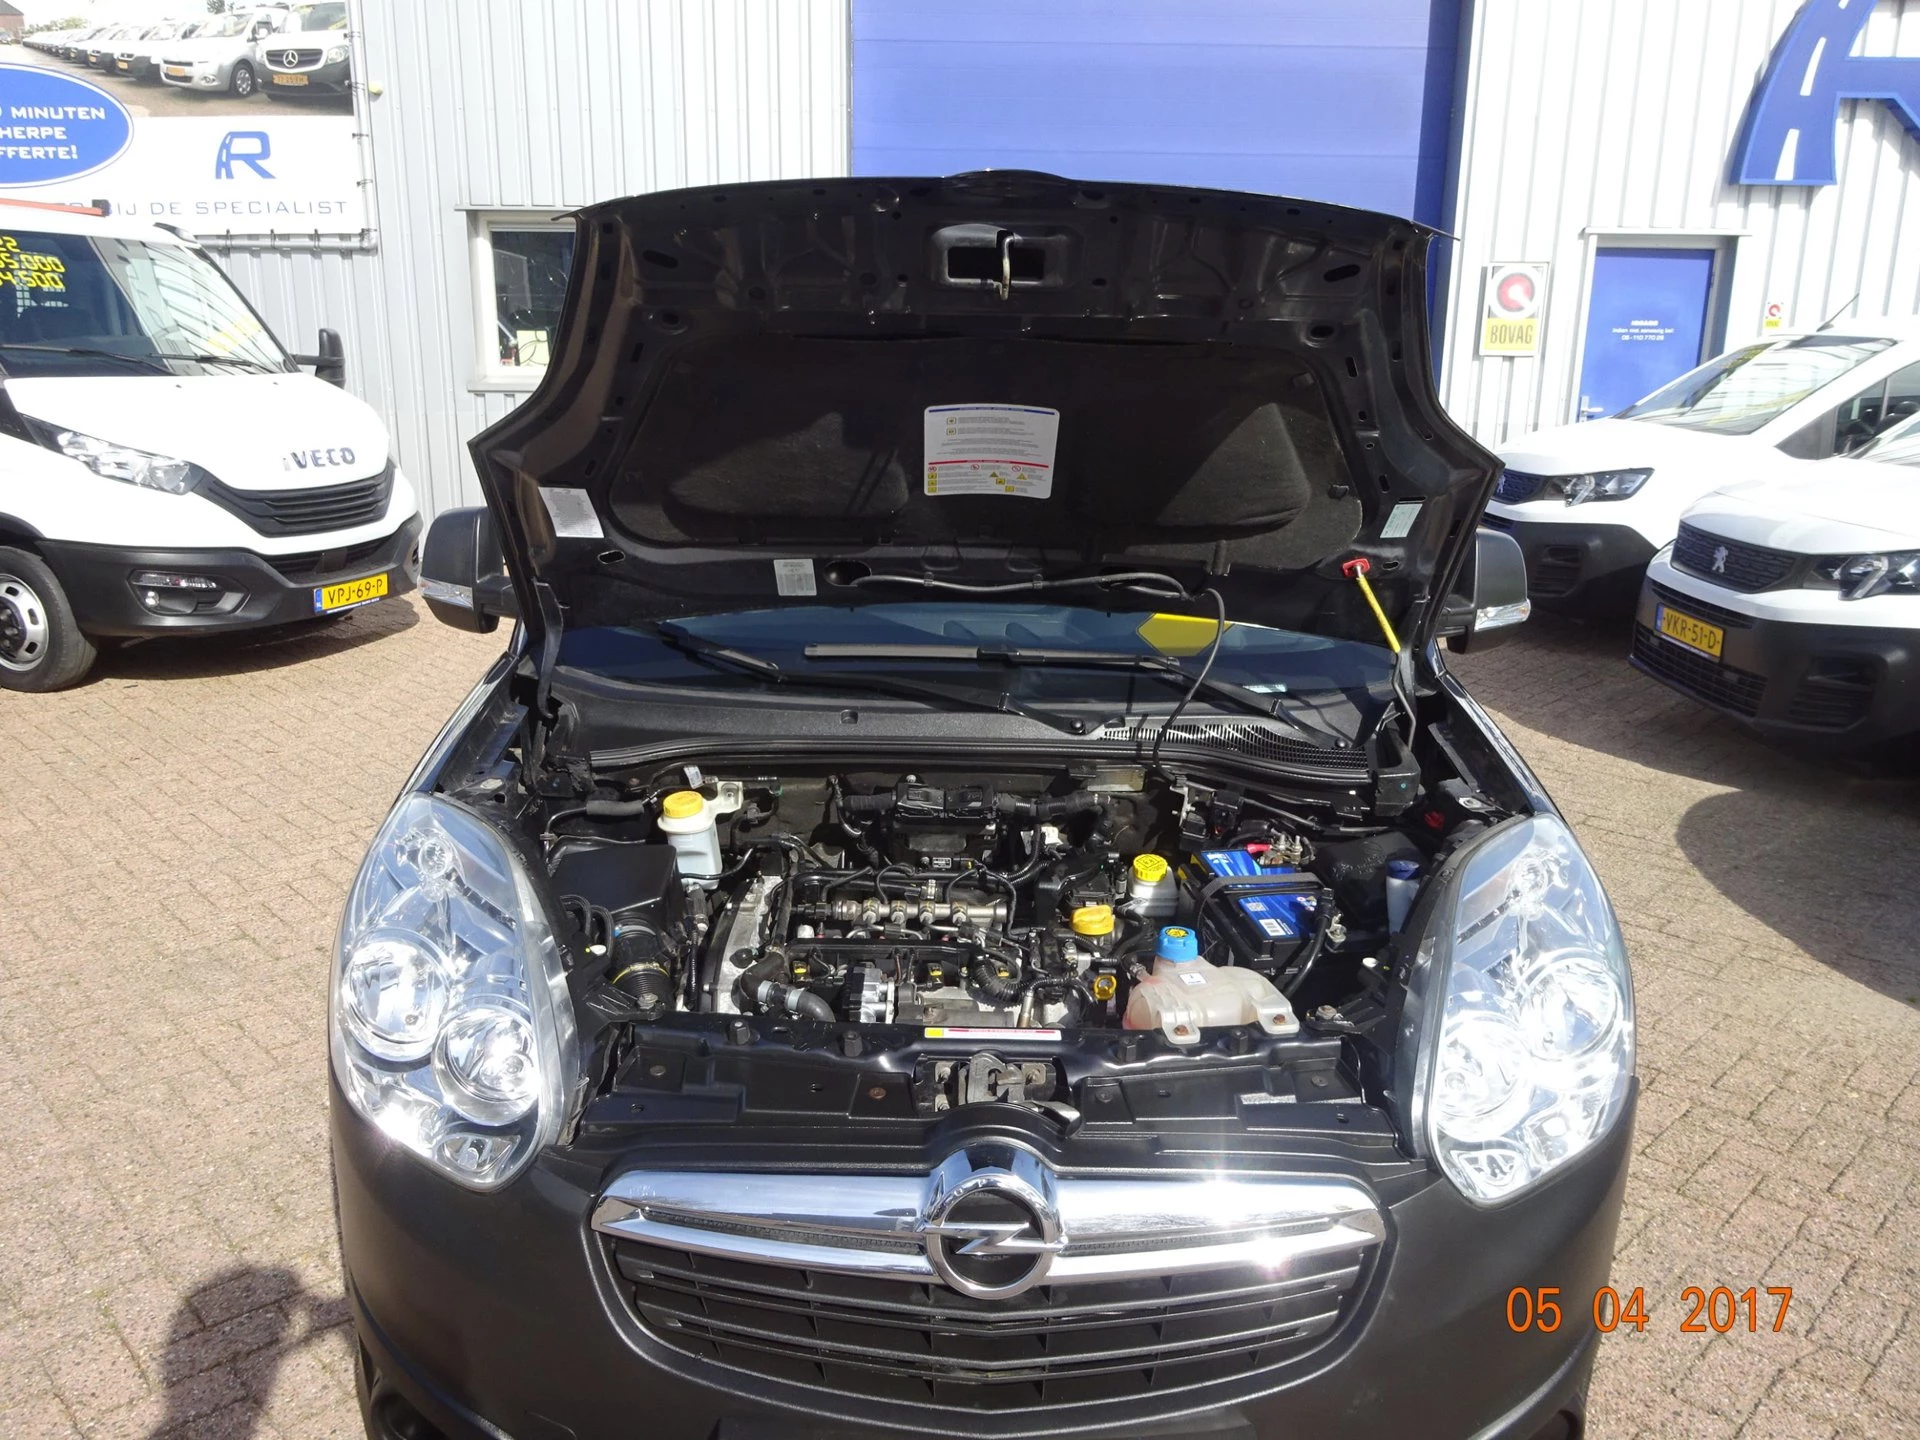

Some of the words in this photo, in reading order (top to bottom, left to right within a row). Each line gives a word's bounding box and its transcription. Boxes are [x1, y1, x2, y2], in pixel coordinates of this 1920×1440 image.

[10, 106, 106, 120] MINUTEN
[0, 126, 67, 139] HERPE
[150, 202, 182, 215] DE
[196, 201, 348, 215] SPECIALIST
[0, 271, 64, 289] 4.500
[1490, 324, 1533, 344] BOVAG
[282, 446, 356, 472] IVECO
[327, 578, 383, 605] VPJ-69-P
[1665, 612, 1717, 649] VKR-51-D
